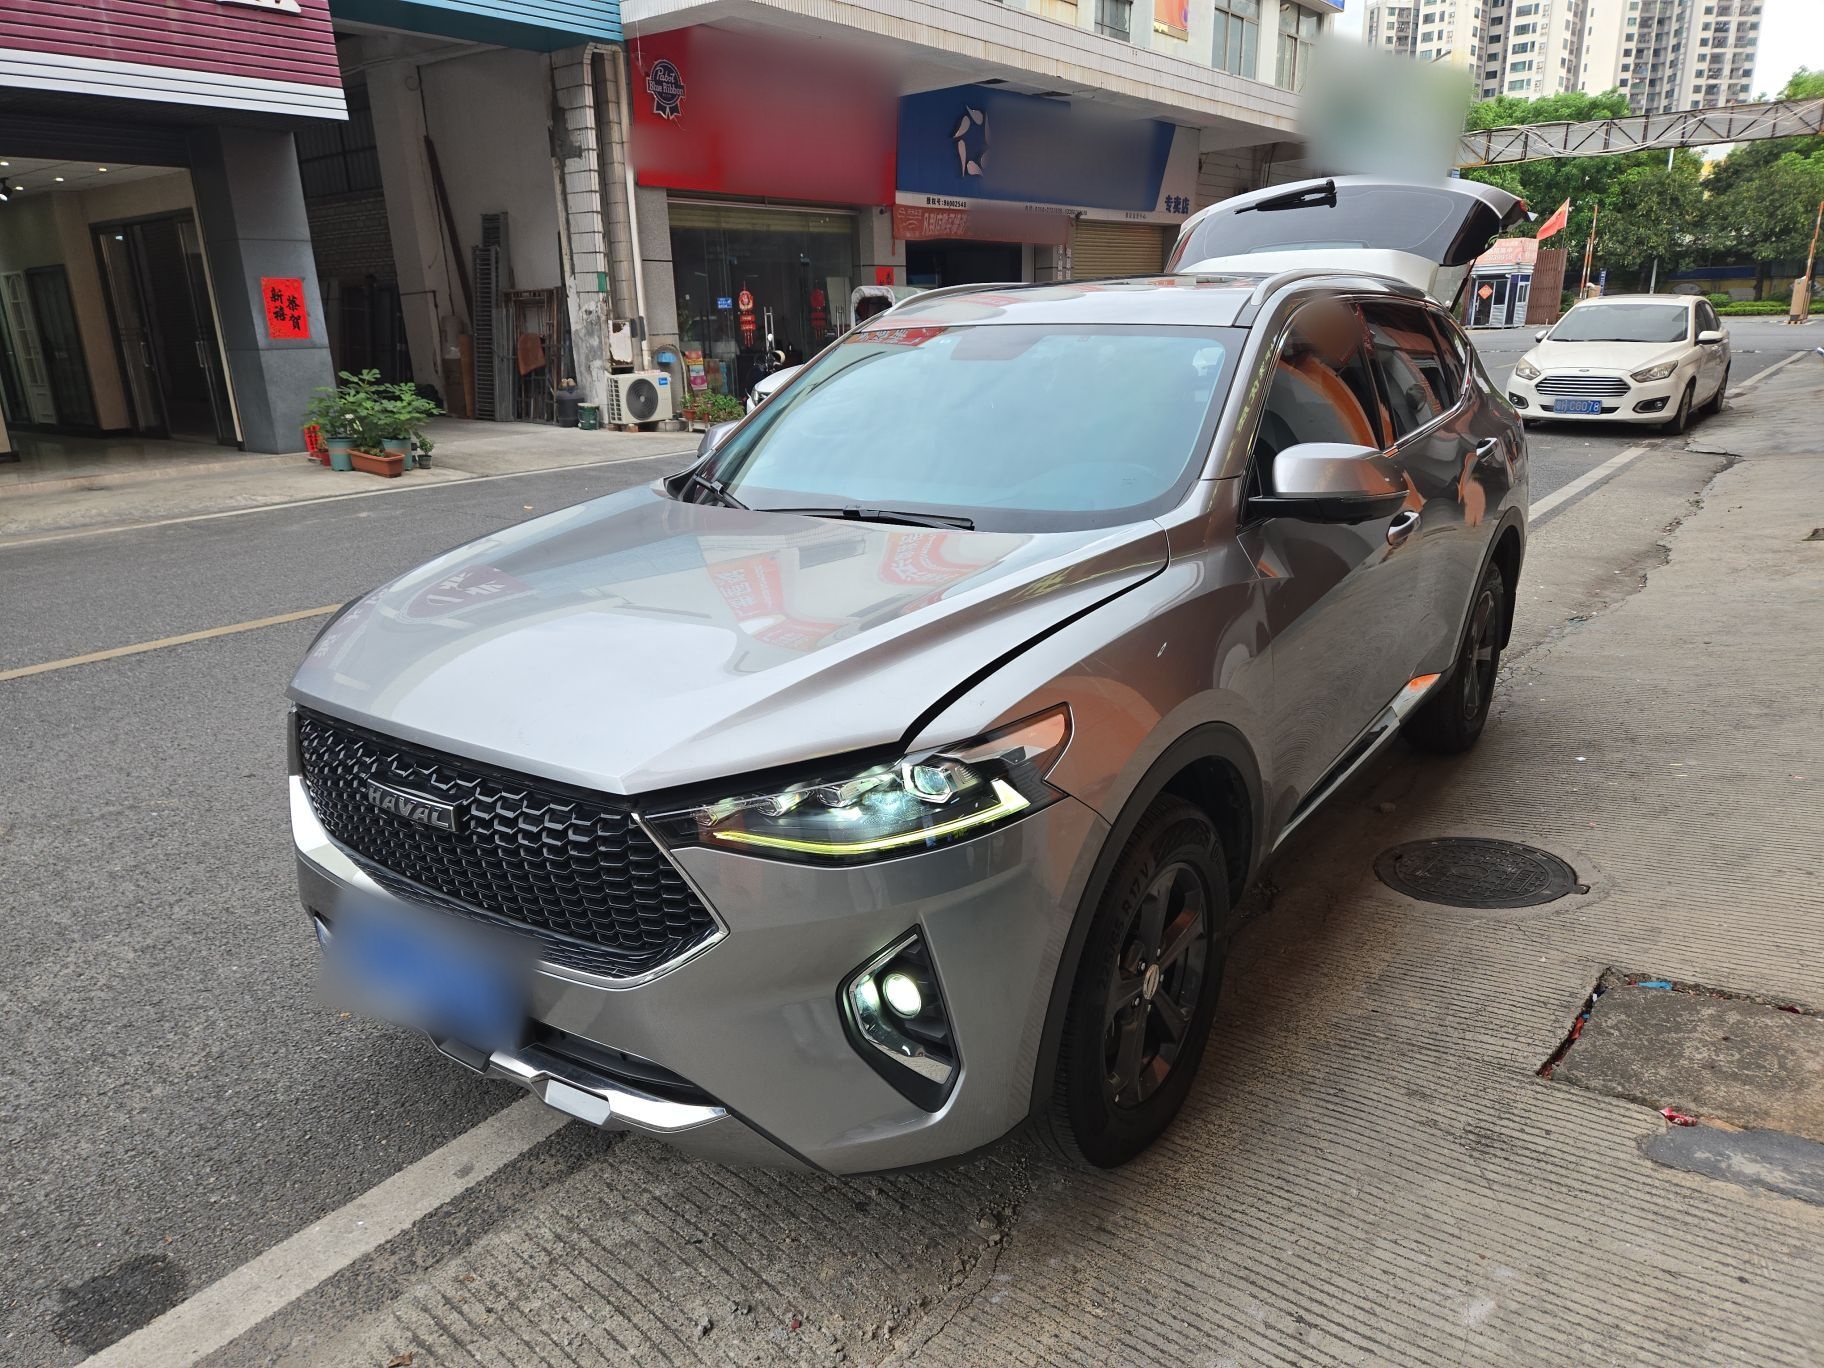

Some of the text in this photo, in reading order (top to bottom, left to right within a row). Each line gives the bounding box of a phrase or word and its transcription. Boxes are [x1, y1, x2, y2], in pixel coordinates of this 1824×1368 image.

[656, 67, 676, 83] Pabst
[649, 80, 684, 96] Blue Ribbon
[1165, 194, 1190, 214] 专卖店
[368, 785, 449, 828] HAVAL
